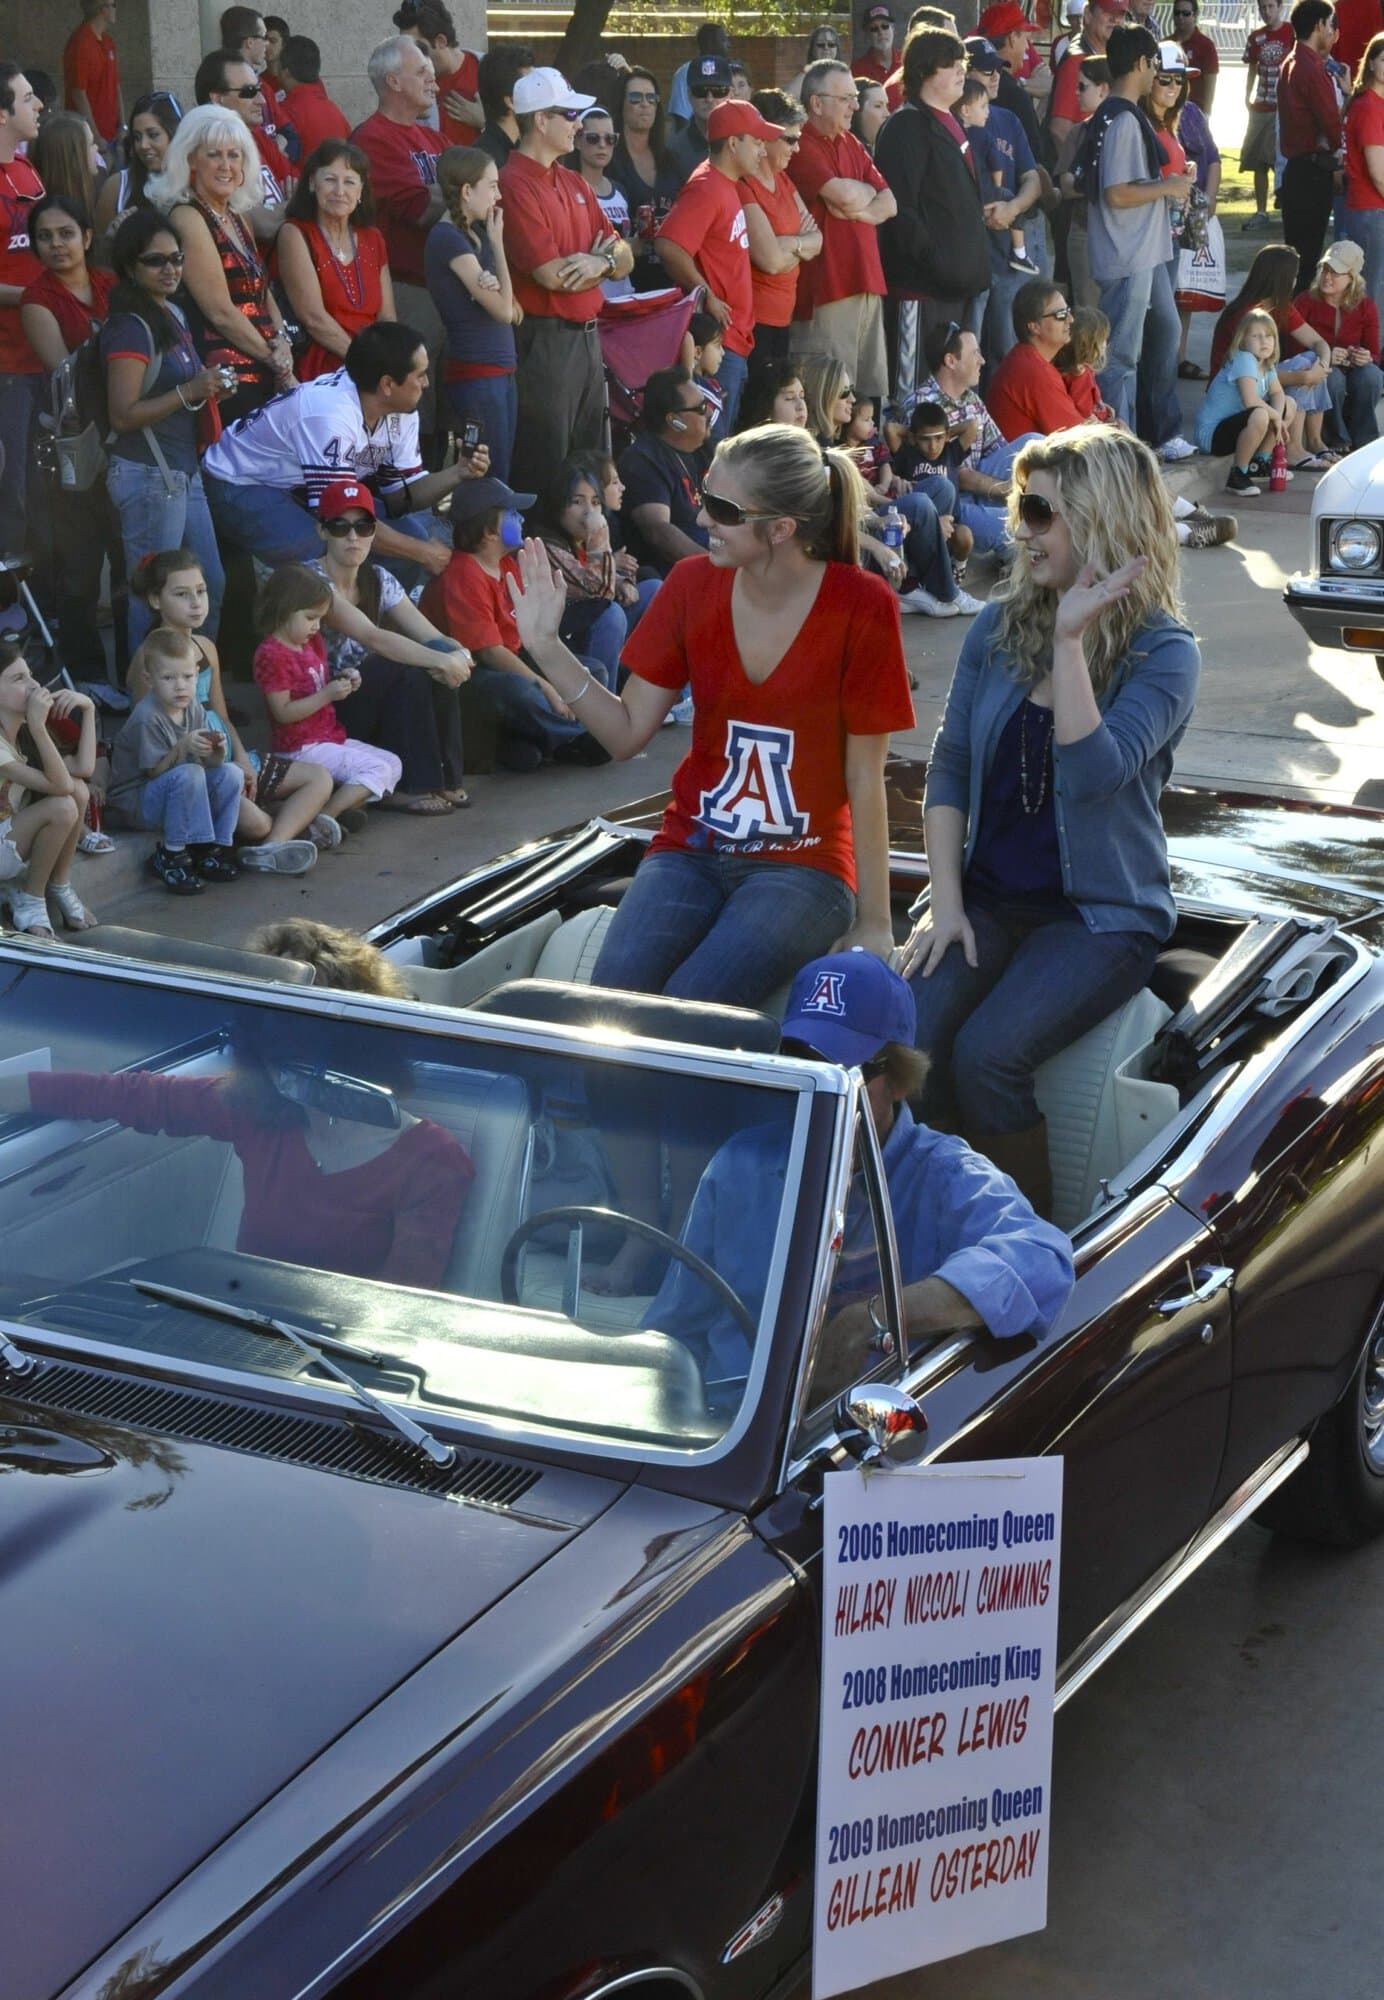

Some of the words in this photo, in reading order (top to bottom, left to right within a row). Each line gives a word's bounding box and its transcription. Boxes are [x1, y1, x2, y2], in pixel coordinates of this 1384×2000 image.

[1192, 245, 1215, 267] A
[692, 720, 810, 839] A
[801, 971, 846, 1016] A
[838, 1521, 883, 1563] 2006
[887, 1514, 999, 1557] Homecoming
[1002, 1510, 1055, 1548] Queen
[835, 1578, 897, 1637] HILARY
[904, 1569, 970, 1626] NICCOLI
[976, 1558, 1052, 1615] CUMMINS
[842, 1666, 887, 1710] 2008
[890, 1651, 1001, 1701] Homecoming
[1004, 1645, 1042, 1681] King
[848, 1711, 947, 1780] CONNER
[957, 1695, 1030, 1756] LEWIS
[828, 1817, 873, 1864] 2009
[876, 1796, 988, 1852] Homecoming
[991, 1785, 1043, 1827] Queen
[827, 1857, 921, 1931] GILLEAN
[930, 1828, 1041, 1903] OSTERDAY
